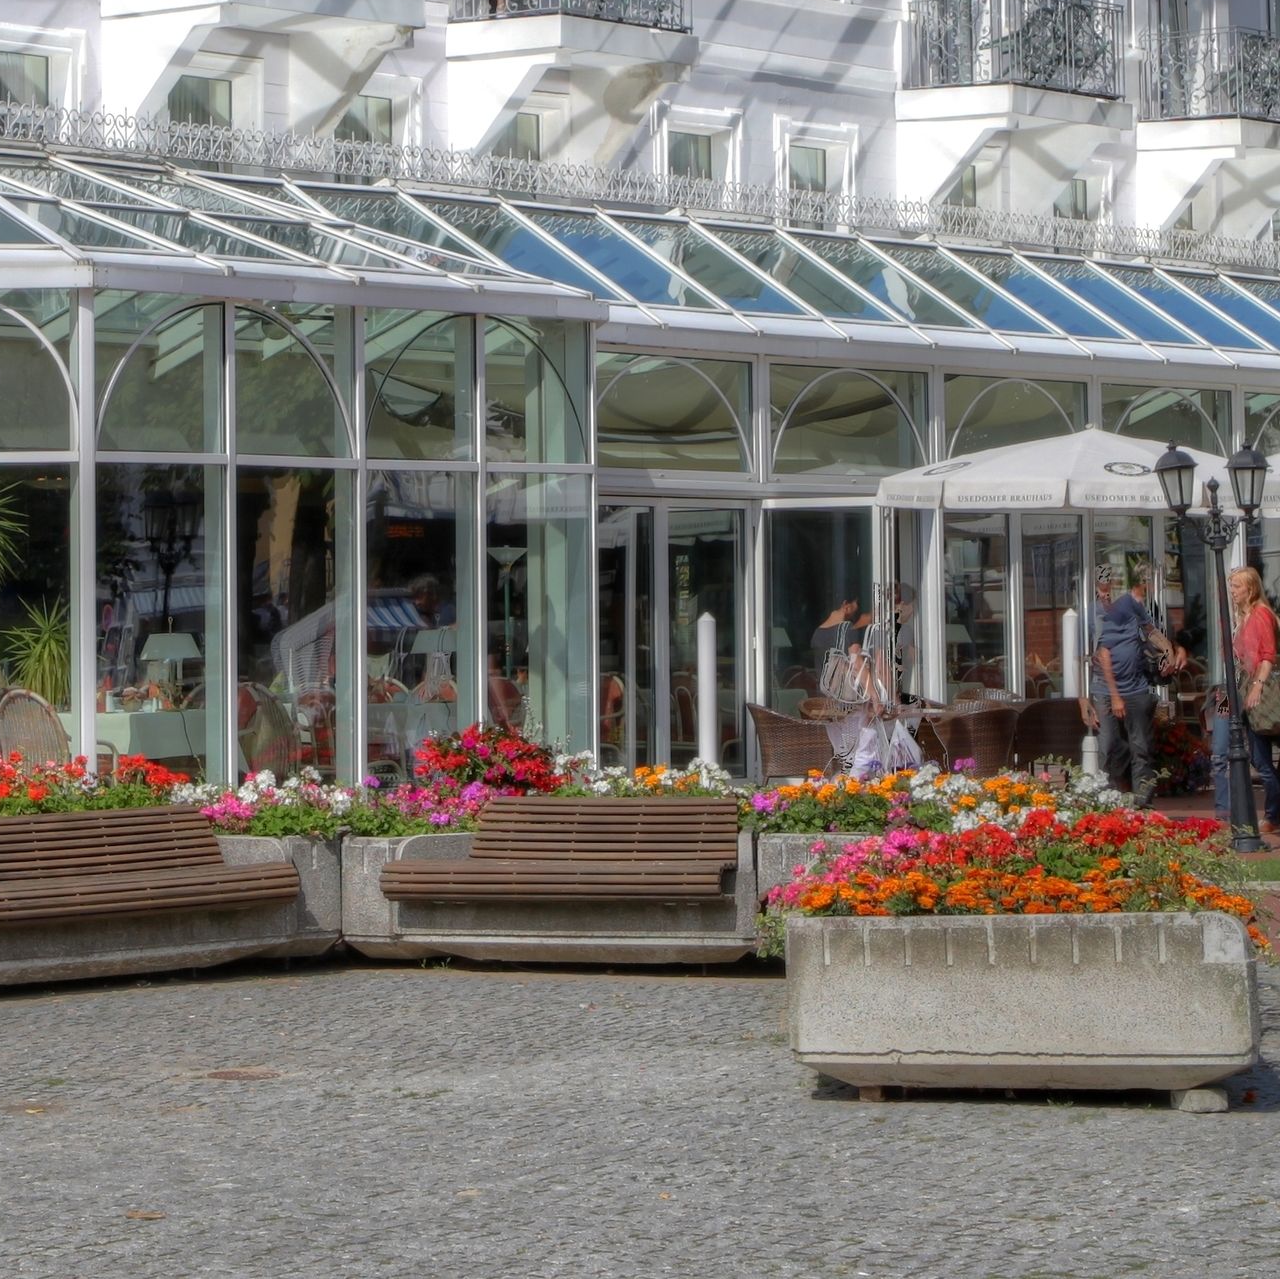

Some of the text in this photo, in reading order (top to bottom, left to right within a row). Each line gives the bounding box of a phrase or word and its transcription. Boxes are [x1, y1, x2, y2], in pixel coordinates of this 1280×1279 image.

[958, 494, 1052, 503] USEDOMER BRAUHAUS
[1085, 494, 1168, 503] USEDOMER BRAU
